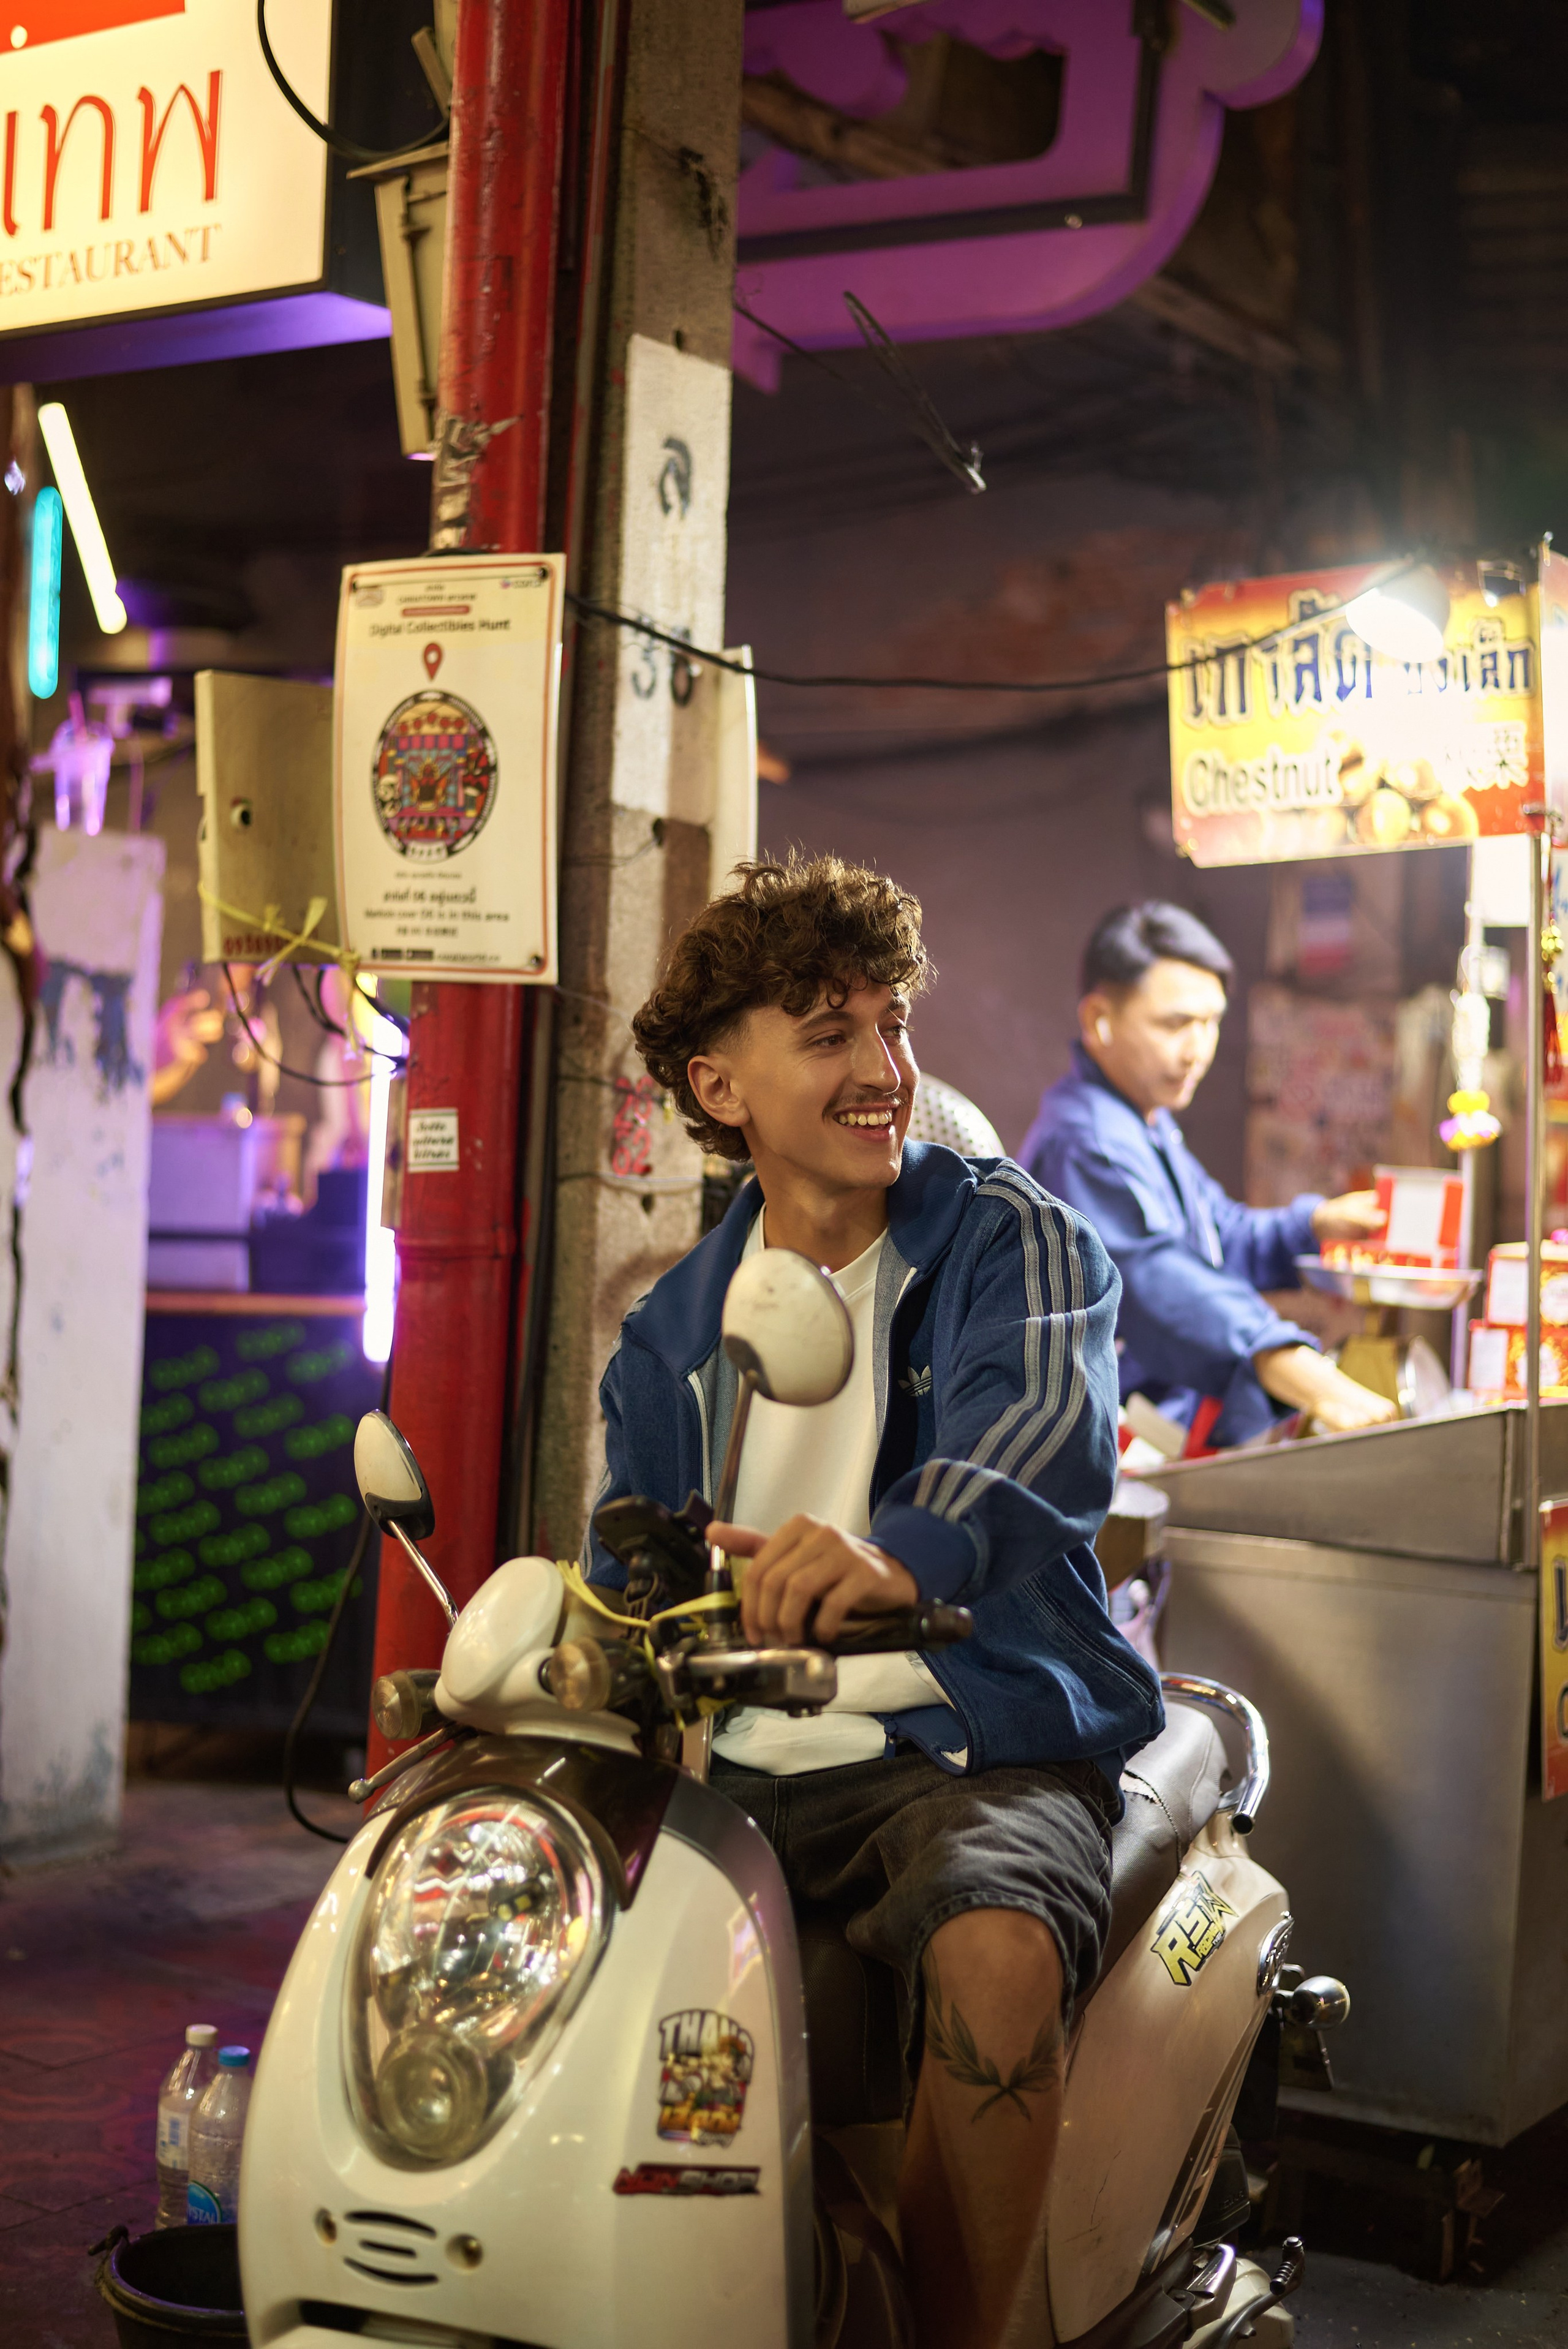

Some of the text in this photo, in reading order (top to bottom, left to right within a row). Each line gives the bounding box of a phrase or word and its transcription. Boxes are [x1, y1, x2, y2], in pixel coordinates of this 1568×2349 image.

[370, 619, 511, 637] Digital Collectibles Hunt
[1187, 748, 1335, 810] Chestnut
